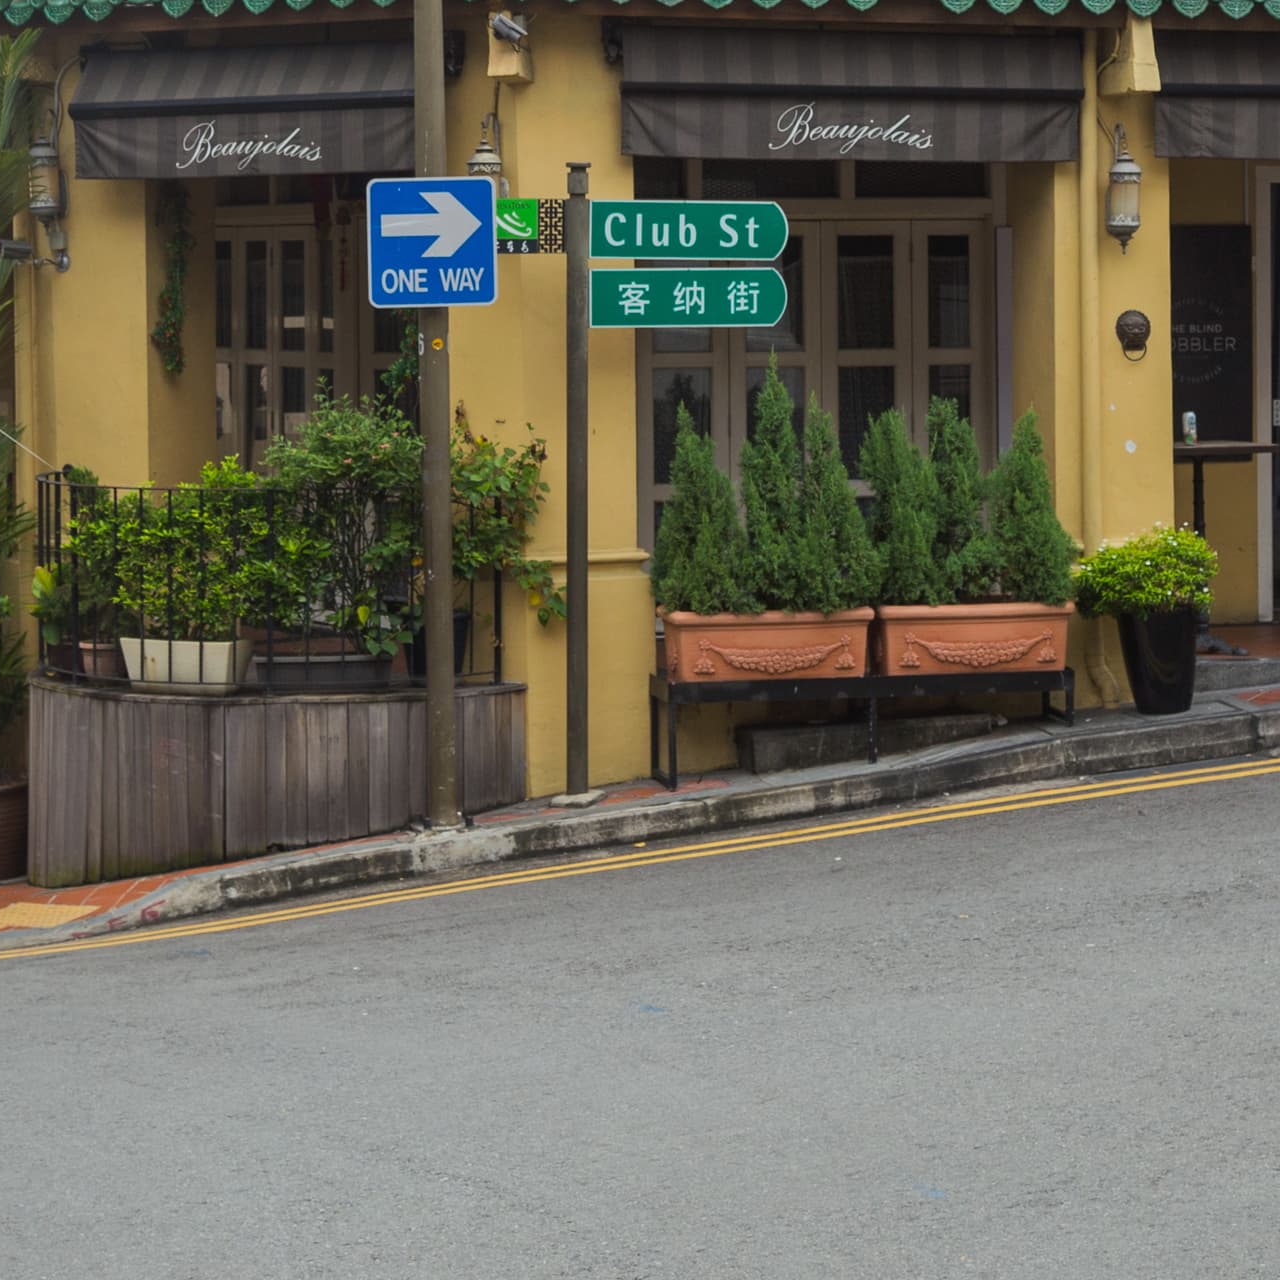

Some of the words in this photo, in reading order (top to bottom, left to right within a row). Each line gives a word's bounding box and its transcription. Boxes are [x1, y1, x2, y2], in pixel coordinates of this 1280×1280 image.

[175, 119, 323, 171] Beaujolais
[768, 101, 934, 155] Beaujolais
[604, 212, 698, 248] Club
[719, 213, 760, 248] St
[381, 268, 429, 294] ONE
[439, 267, 485, 293] WAY
[618, 280, 761, 316] 客纳街
[1172, 323, 1186, 333] HE
